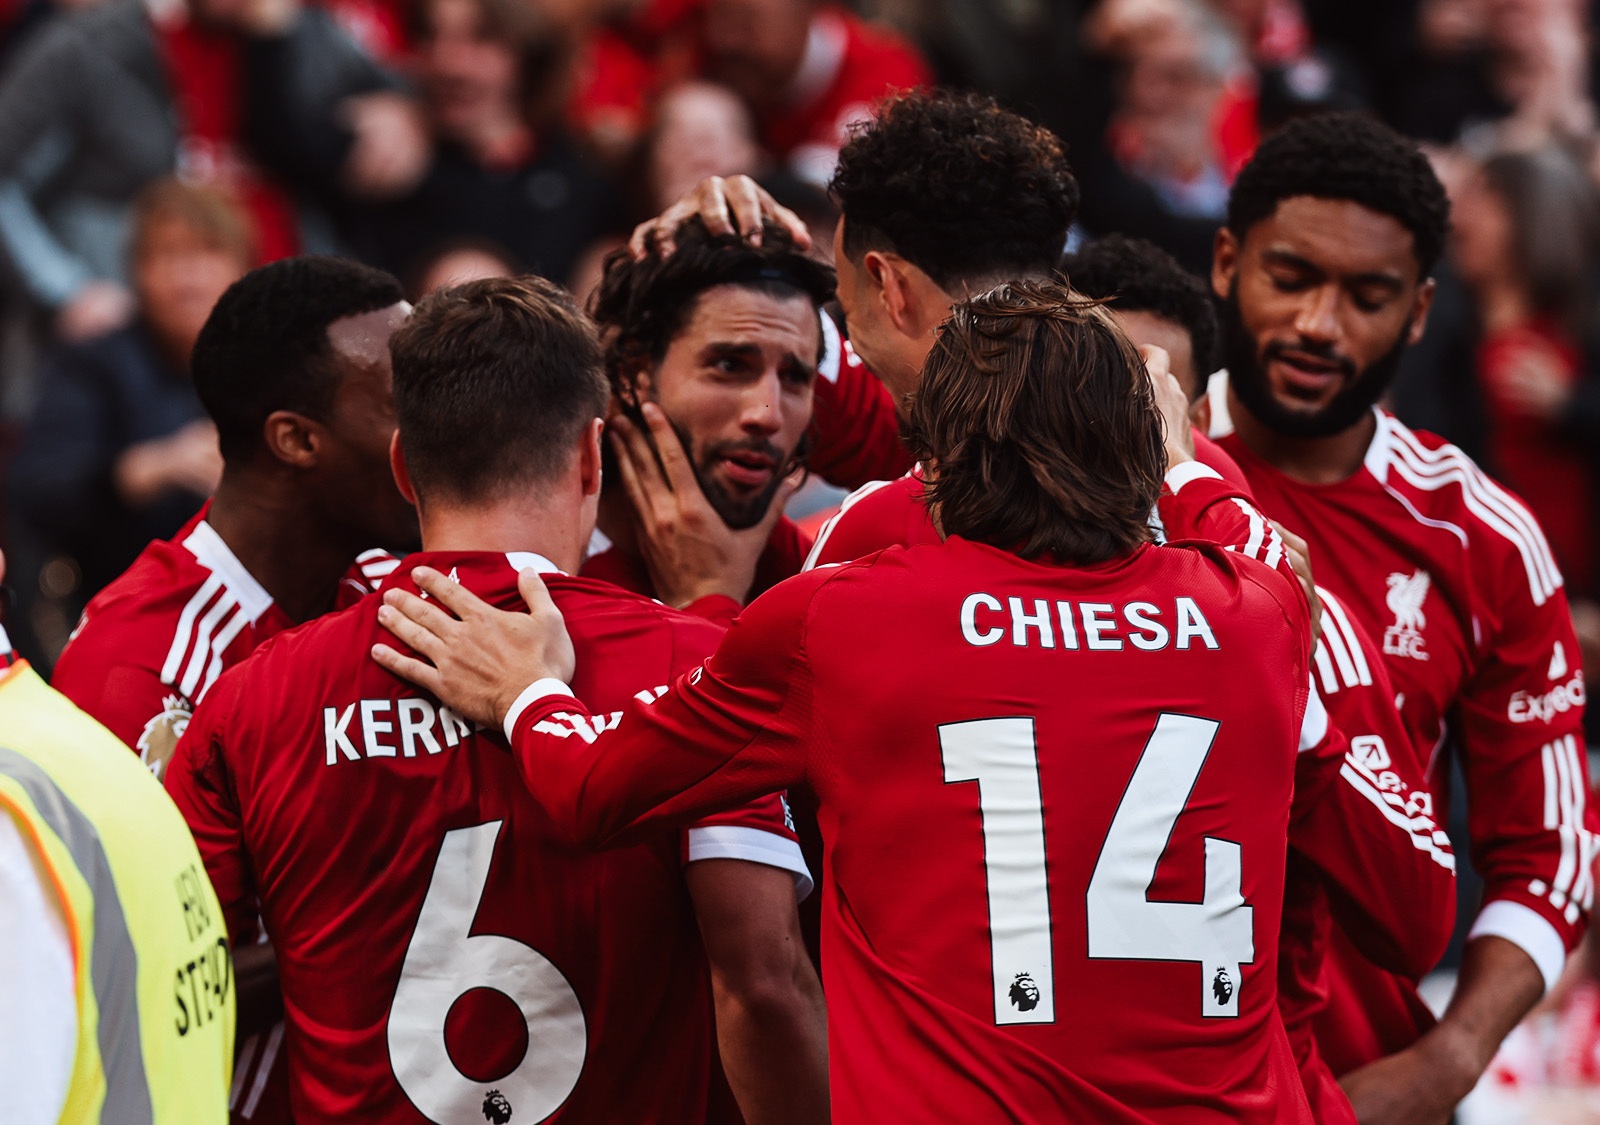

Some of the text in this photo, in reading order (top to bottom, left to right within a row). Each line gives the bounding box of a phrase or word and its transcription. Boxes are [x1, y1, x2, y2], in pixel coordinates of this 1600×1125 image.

[960, 592, 1220, 651] CHIESA
[1508, 669, 1586, 725] Exped
[937, 711, 1255, 1025] 14
[386, 818, 588, 1125] 6
